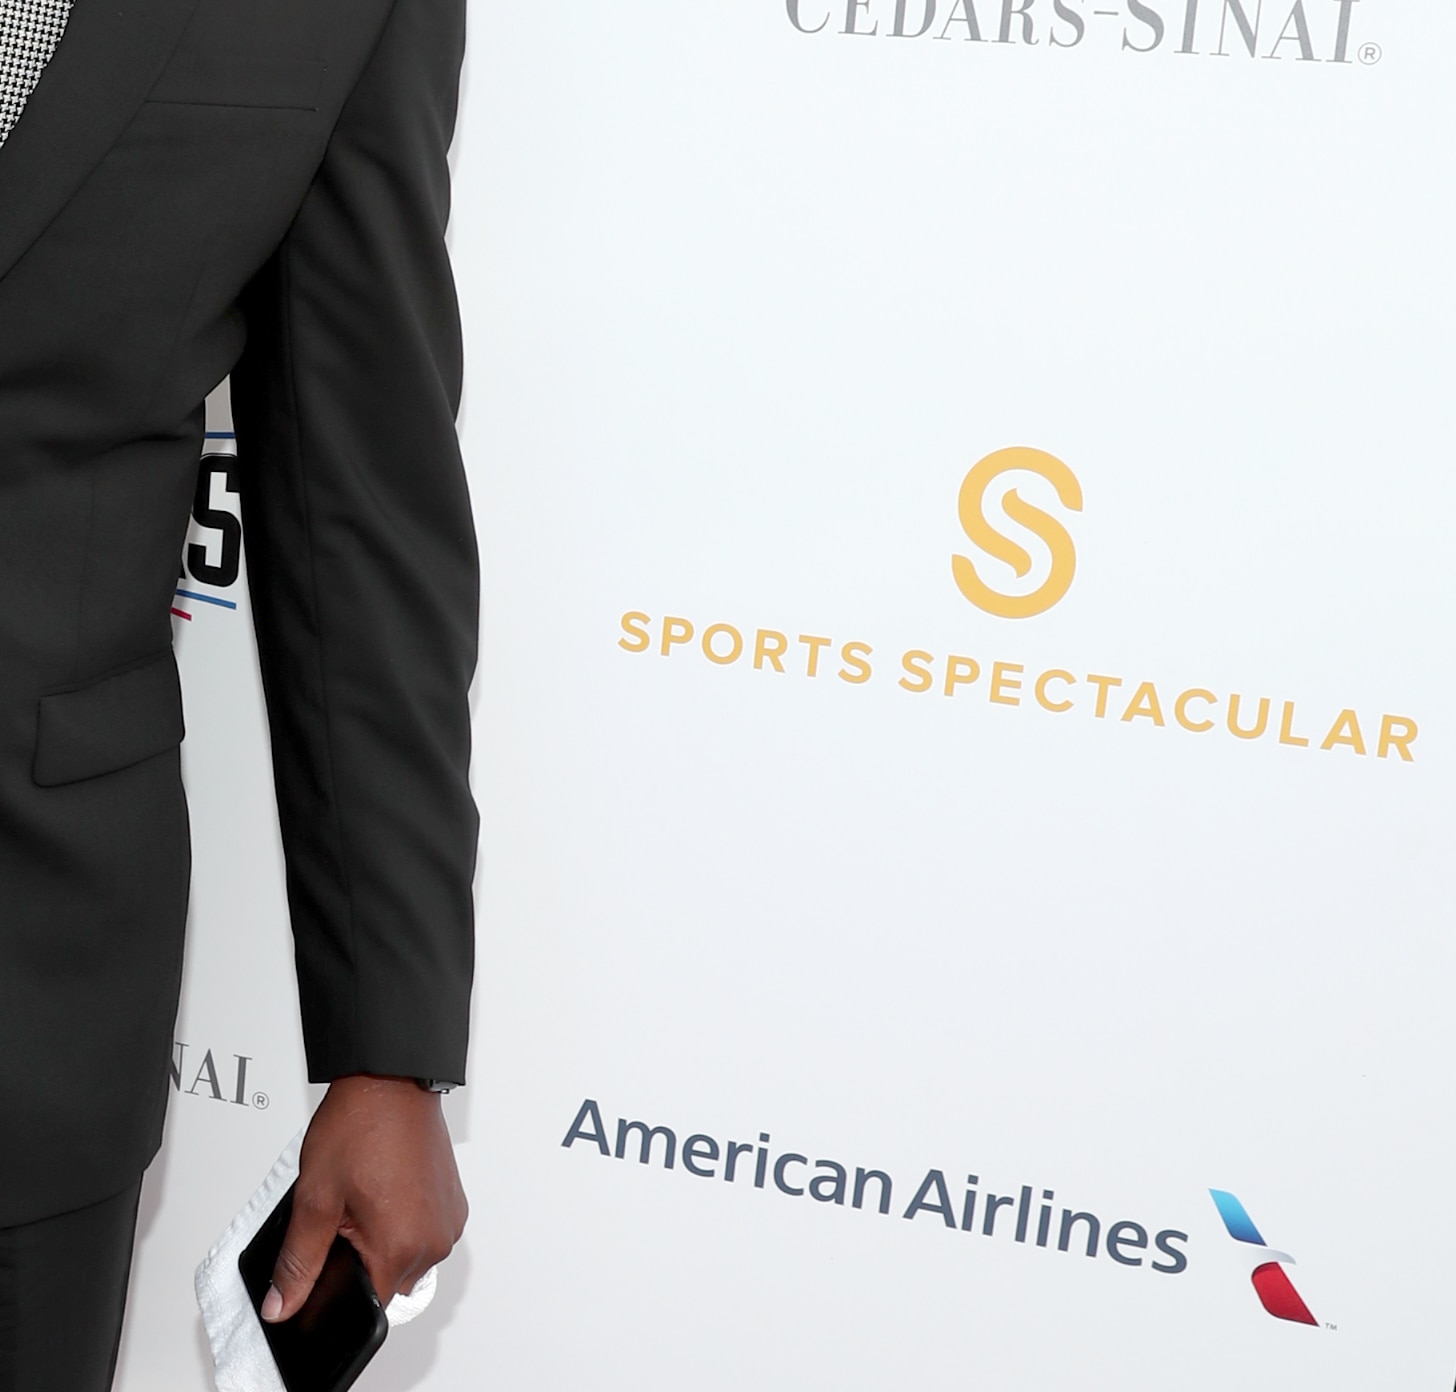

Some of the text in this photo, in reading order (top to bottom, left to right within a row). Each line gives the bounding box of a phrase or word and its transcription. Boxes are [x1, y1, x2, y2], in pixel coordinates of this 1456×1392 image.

[617, 610, 1420, 763] SPORTS SPECTACULAR
[560, 1098, 1190, 1276] American Airlines
